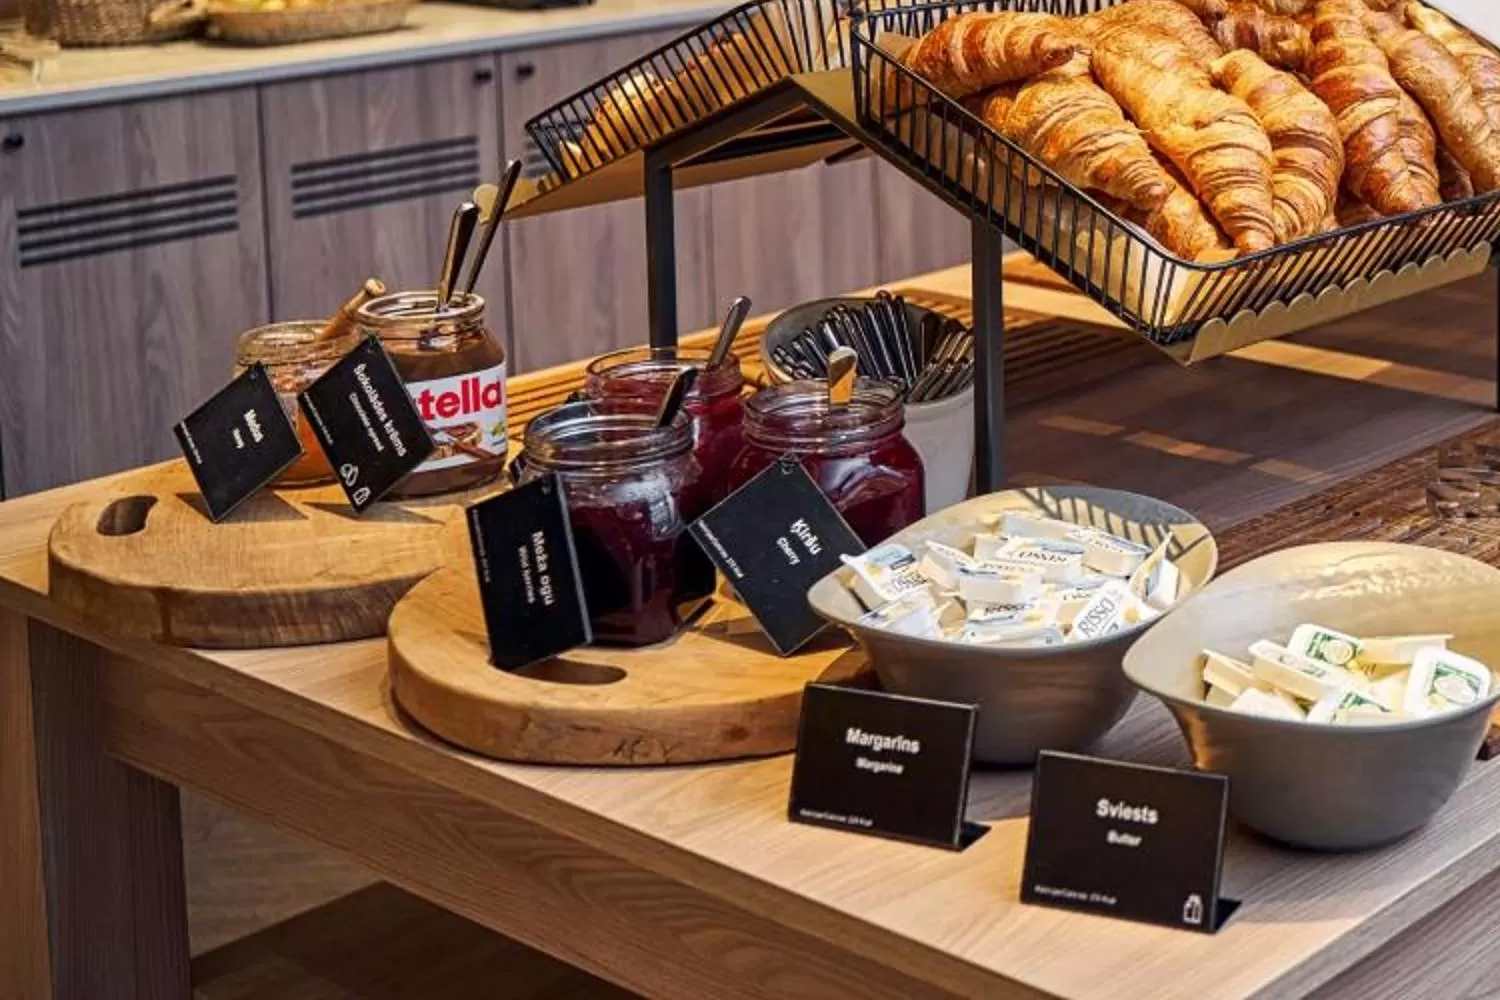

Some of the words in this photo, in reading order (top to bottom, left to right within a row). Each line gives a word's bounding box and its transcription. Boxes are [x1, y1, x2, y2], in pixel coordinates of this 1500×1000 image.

[416, 375, 504, 421] tella
[1077, 596, 1115, 639] RISSO
[1095, 797, 1159, 825] Sviests
[1106, 829, 1143, 847] Butter
